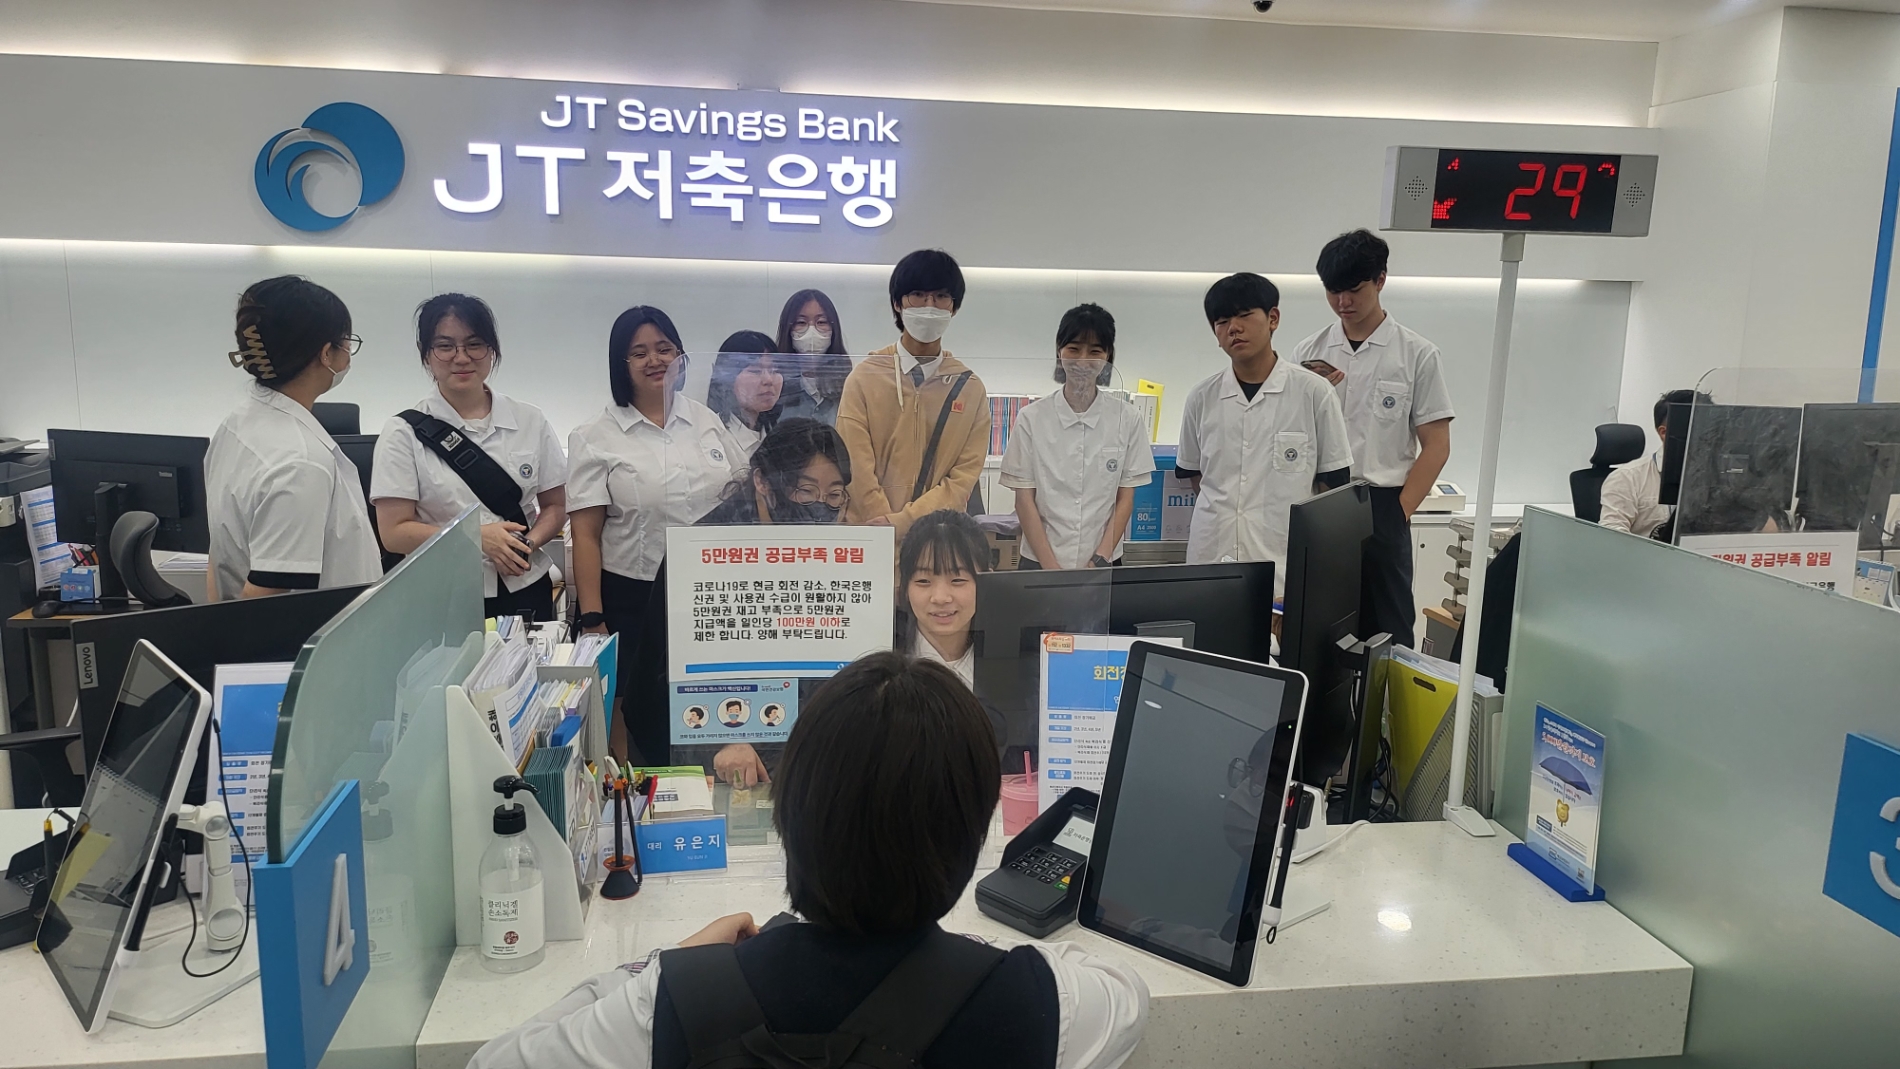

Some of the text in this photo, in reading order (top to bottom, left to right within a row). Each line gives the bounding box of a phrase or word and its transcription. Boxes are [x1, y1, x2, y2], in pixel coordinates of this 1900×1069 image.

[540, 95, 900, 142] JT Savings Bank
[433, 142, 898, 228] JT 저축은행
[1504, 163, 1588, 221] 29
[701, 548, 864, 564] 5만원권 공급부족 알림
[1751, 552, 1802, 568] 공급부족
[1806, 552, 1832, 567] 알림
[693, 580, 872, 592] 코로나19로 현금 회전 감소, 한국은행
[693, 593, 872, 604] 신권 및 사용권 수급이 원활하지 않아
[693, 605, 845, 617] 5만원권 재고 부족으로 5만원권
[693, 617, 851, 630] 지급액을 일인당 100만원 이하로
[693, 629, 848, 642] 제한 합니다. 양해 부탁드립니다.
[83, 646, 93, 685] Lenovo
[647, 833, 721, 851] 대리 유은지
[324, 853, 355, 986] 4
